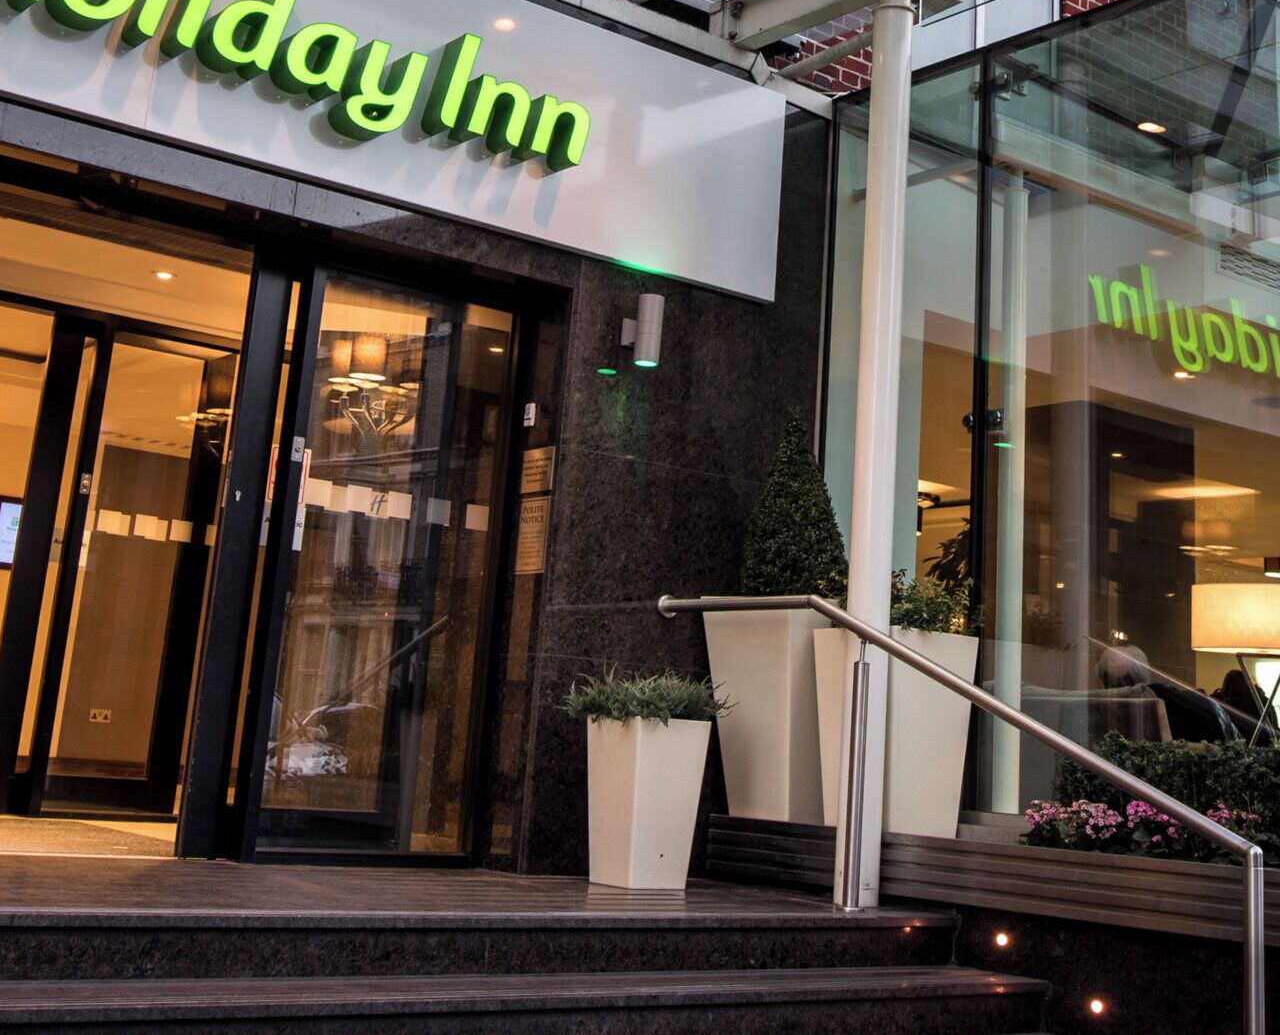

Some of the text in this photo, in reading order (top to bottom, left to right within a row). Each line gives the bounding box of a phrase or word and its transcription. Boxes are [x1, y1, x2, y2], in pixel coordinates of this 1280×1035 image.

[439, 32, 591, 168] Inn
[522, 505, 545, 514] POLITE
[520, 515, 545, 525] NOTICE
